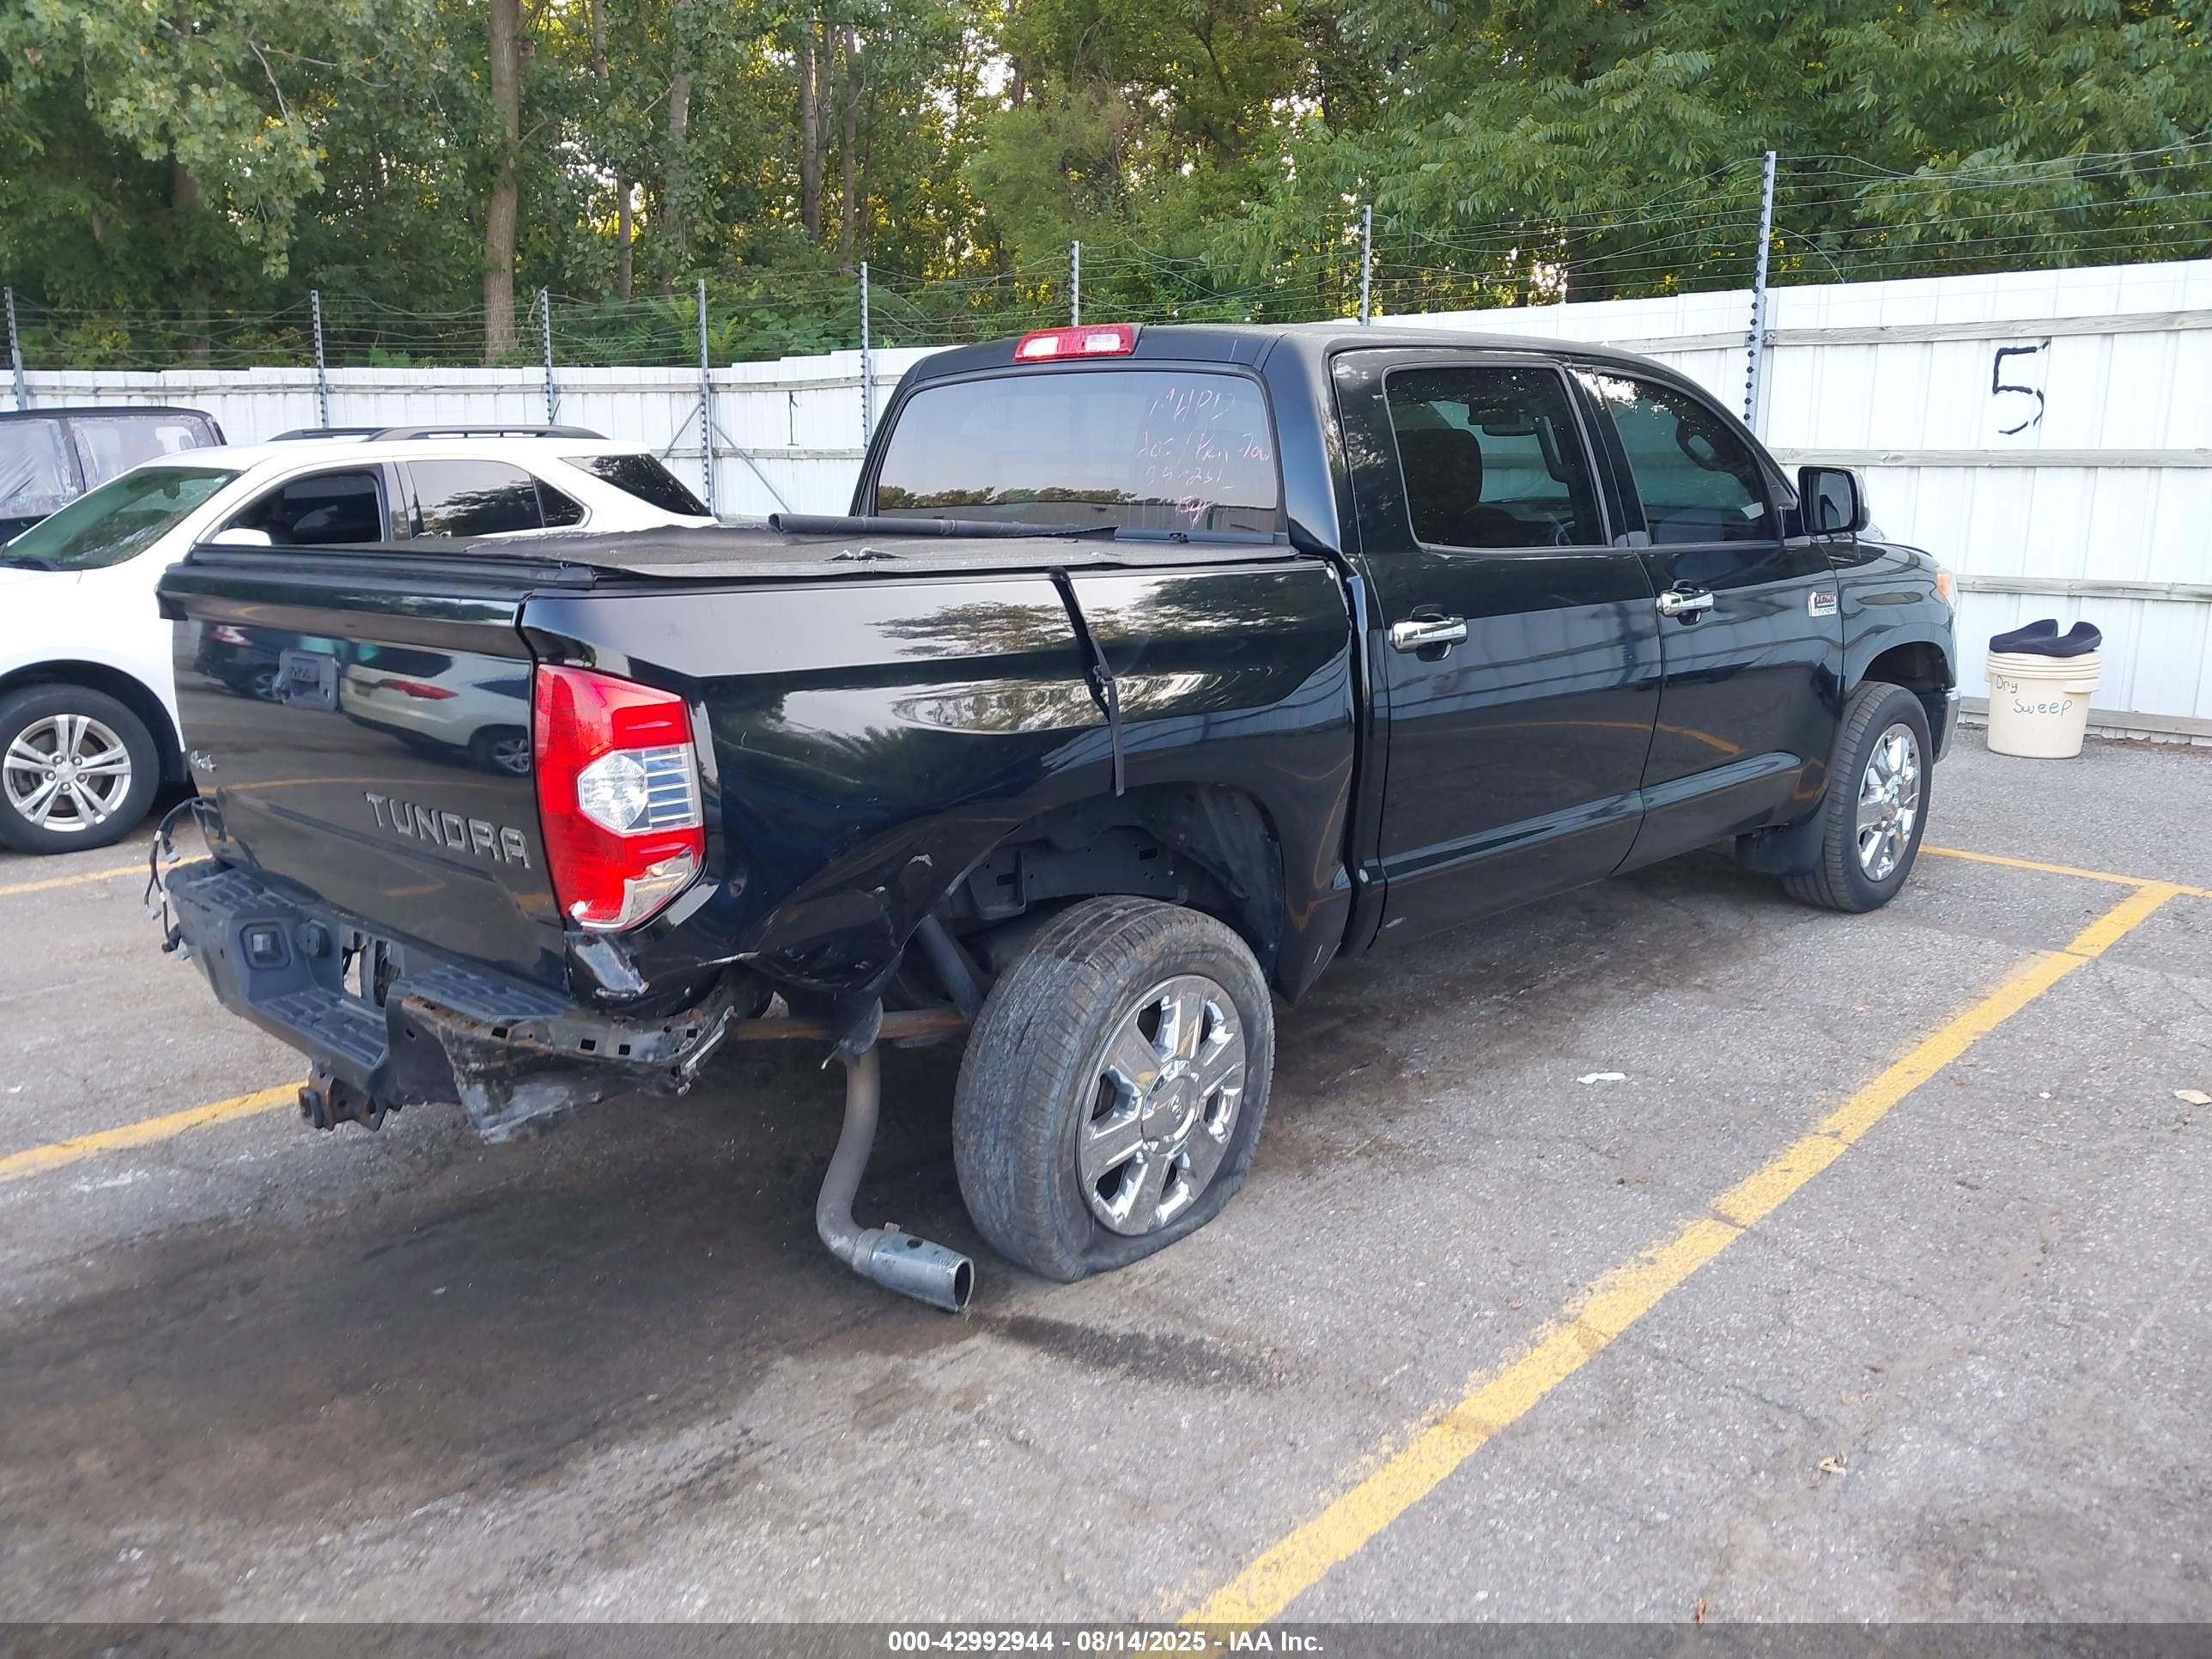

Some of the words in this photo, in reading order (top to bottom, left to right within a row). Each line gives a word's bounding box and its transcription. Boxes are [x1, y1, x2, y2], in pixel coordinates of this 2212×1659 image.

[1992, 341, 2049, 435] 5
[1996, 675, 2018, 694] Dry
[365, 791, 531, 869] TUNDRA
